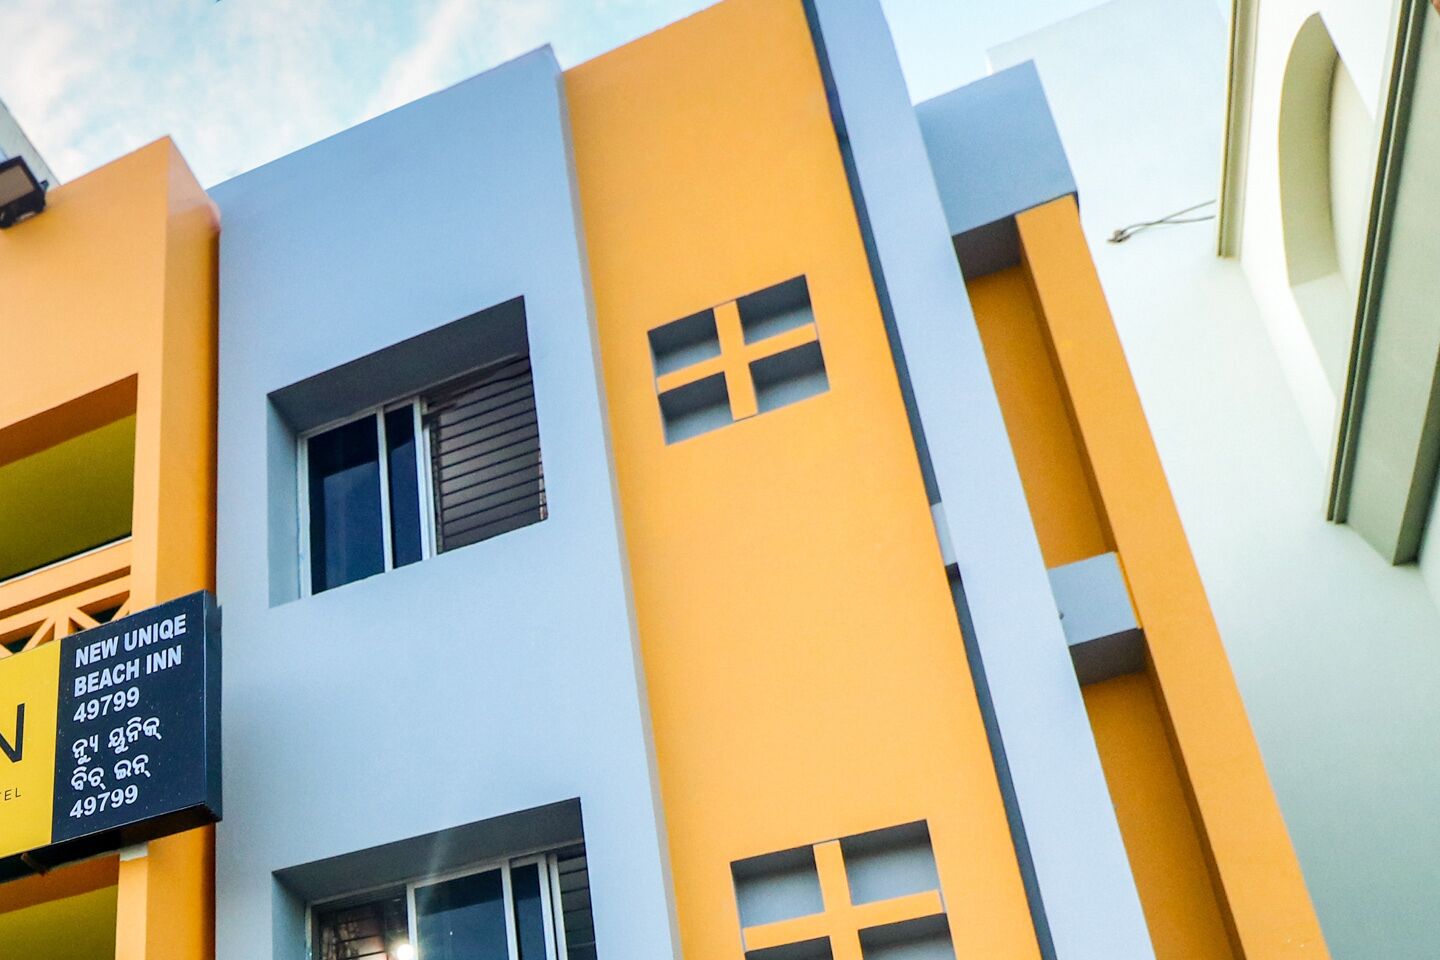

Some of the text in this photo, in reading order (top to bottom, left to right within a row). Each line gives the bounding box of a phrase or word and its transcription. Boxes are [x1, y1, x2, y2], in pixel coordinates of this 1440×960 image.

[75, 614, 186, 668] NEW UNIQE
[74, 645, 182, 697] BEACH INN
[73, 686, 140, 722] 49799
[69, 784, 139, 818] 49799
